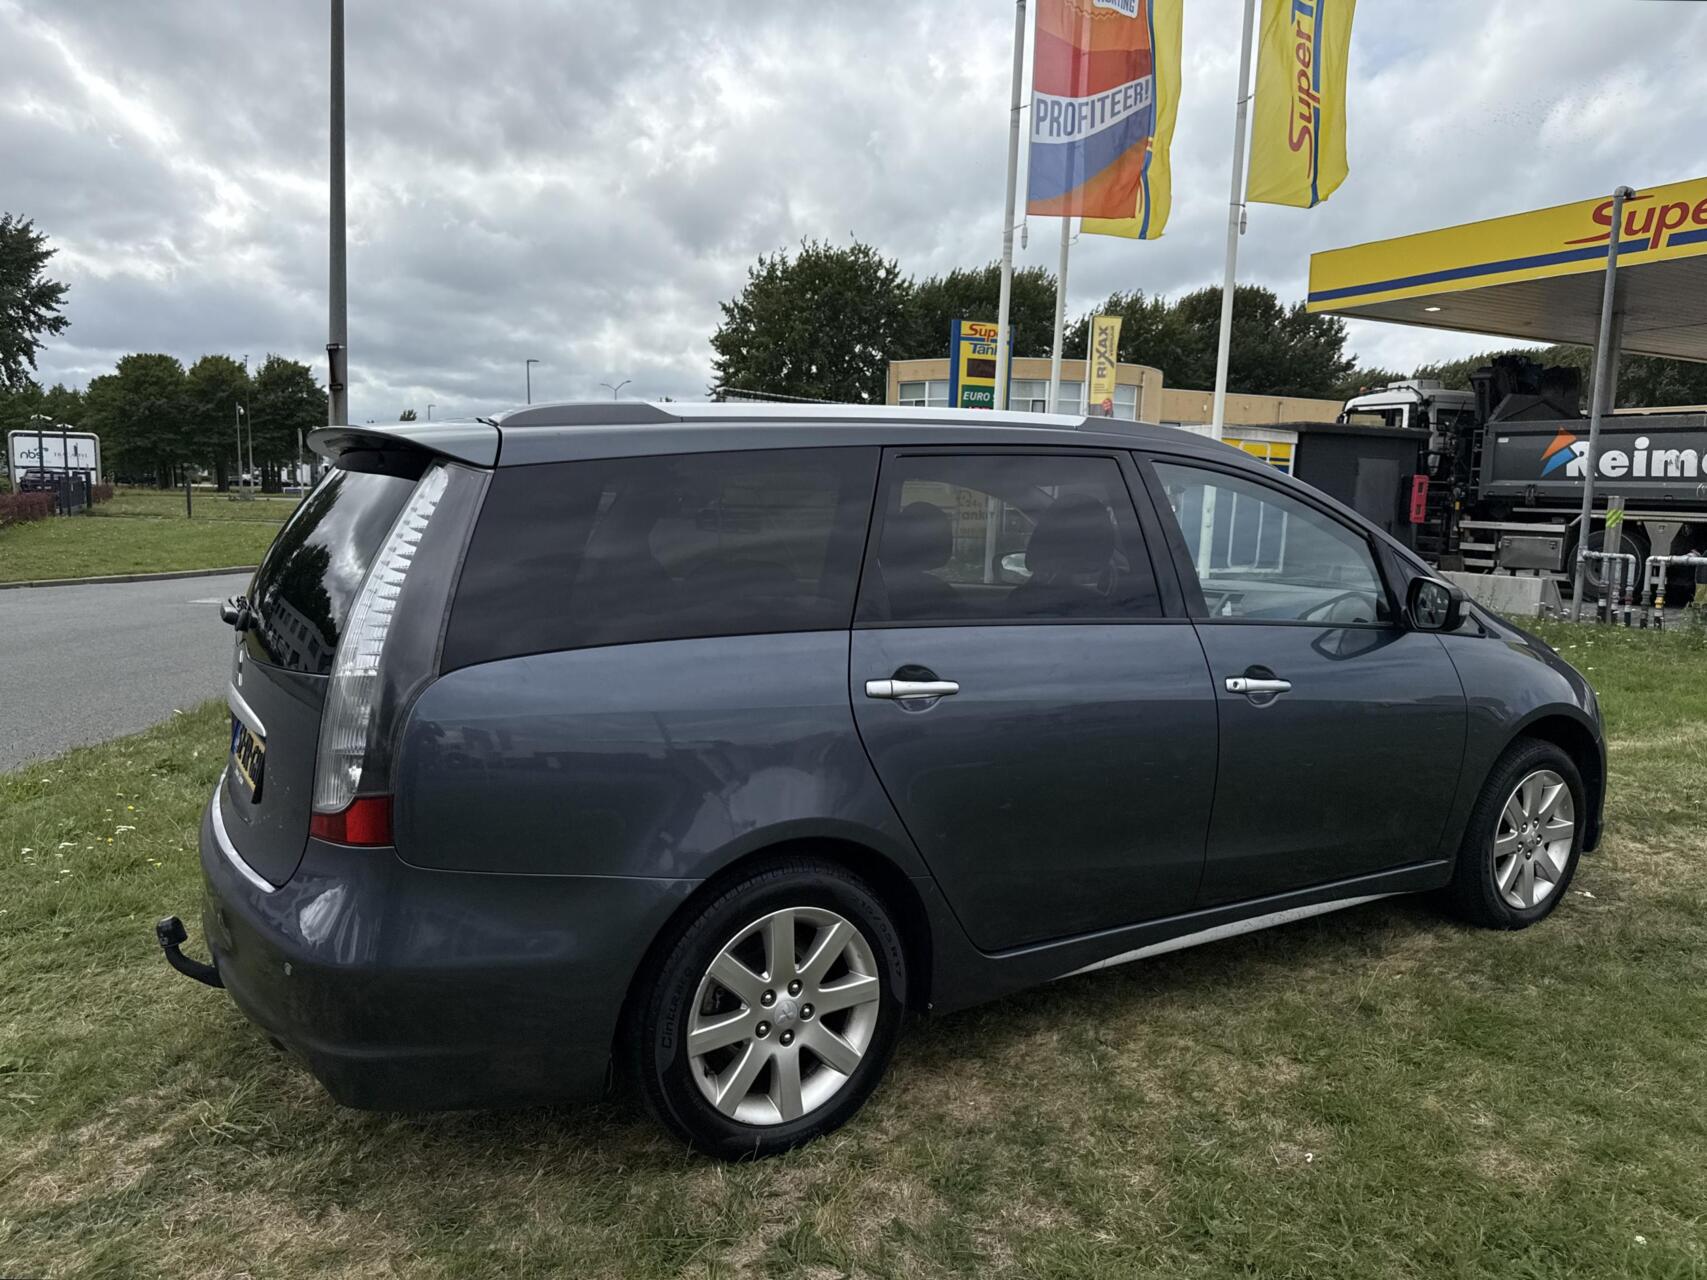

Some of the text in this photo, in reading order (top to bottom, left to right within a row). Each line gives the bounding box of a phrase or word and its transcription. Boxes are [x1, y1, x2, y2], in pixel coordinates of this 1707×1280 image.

[1035, 78, 1149, 138] PROFITEER!
[961, 323, 999, 343] Sup
[963, 391, 990, 402] EURO
[1566, 436, 1707, 477] Reim
